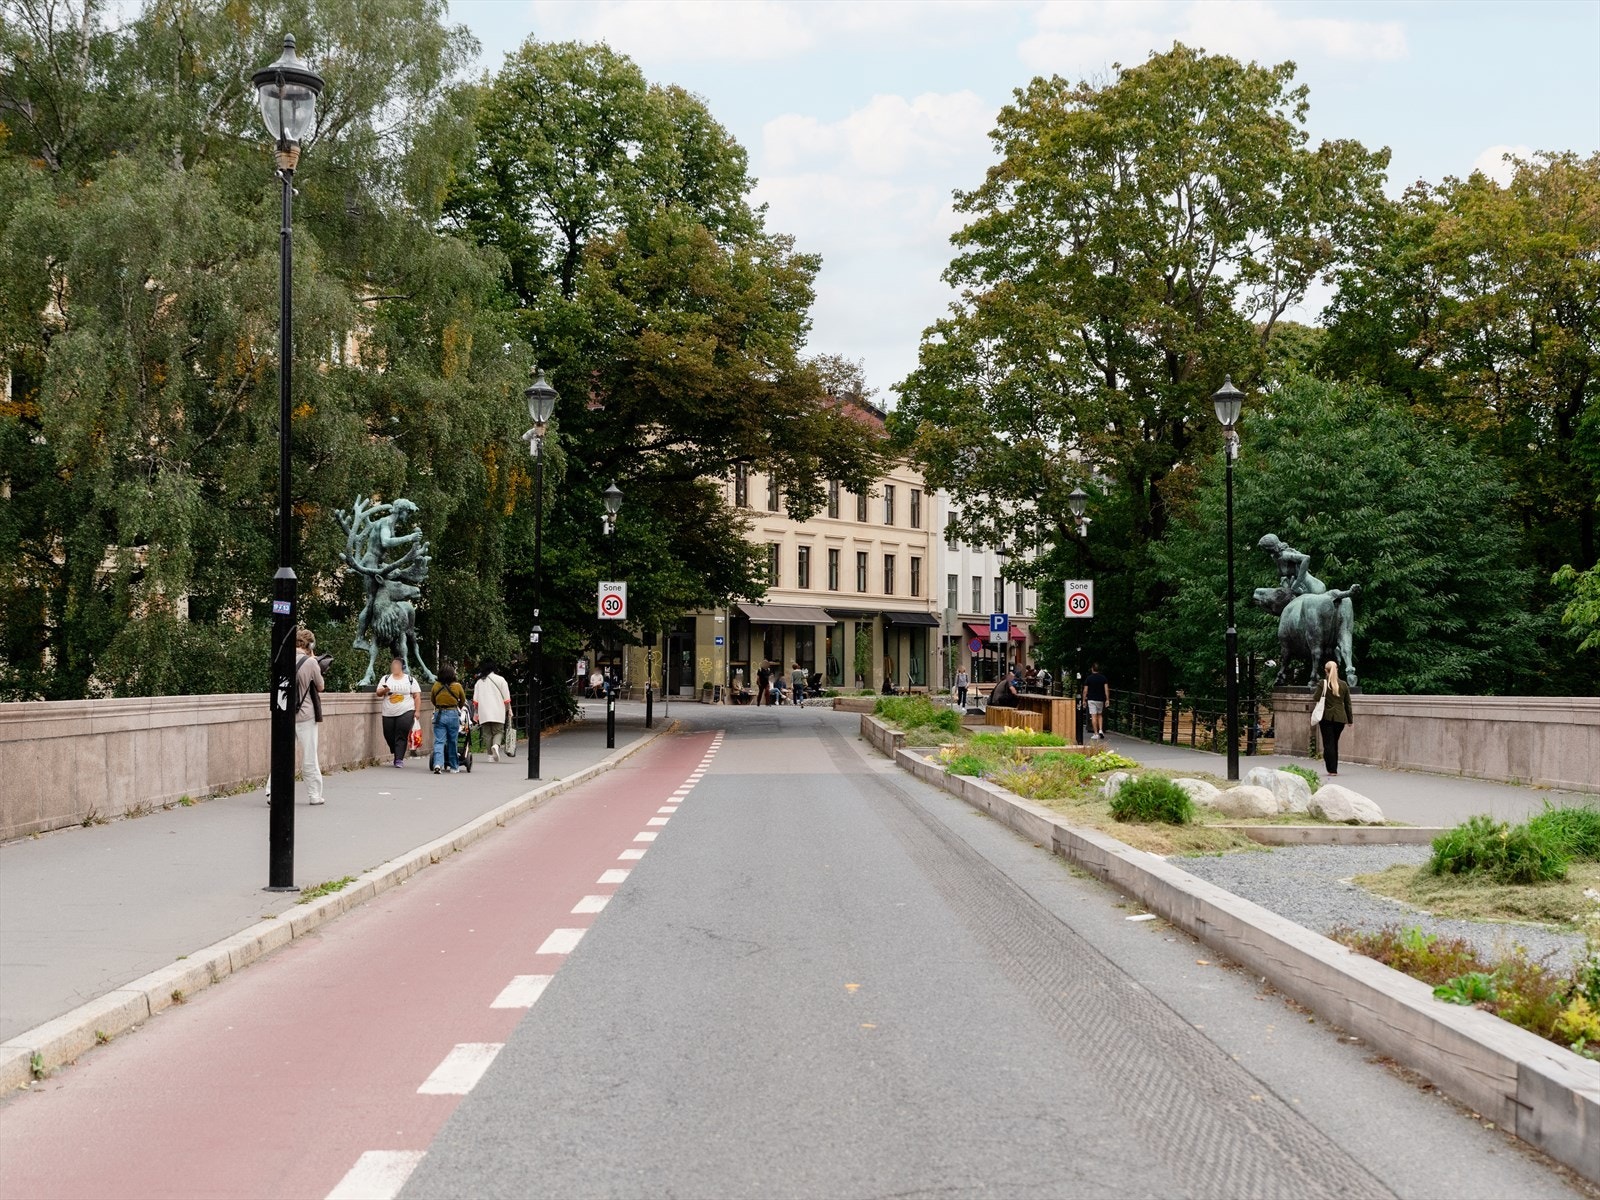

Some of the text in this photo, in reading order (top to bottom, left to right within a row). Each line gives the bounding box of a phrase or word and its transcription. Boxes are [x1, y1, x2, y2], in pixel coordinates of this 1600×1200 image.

[1070, 582, 1088, 590] Sone
[606, 600, 619, 610] 30
[1073, 599, 1086, 609] 30
[995, 616, 1004, 630] P
